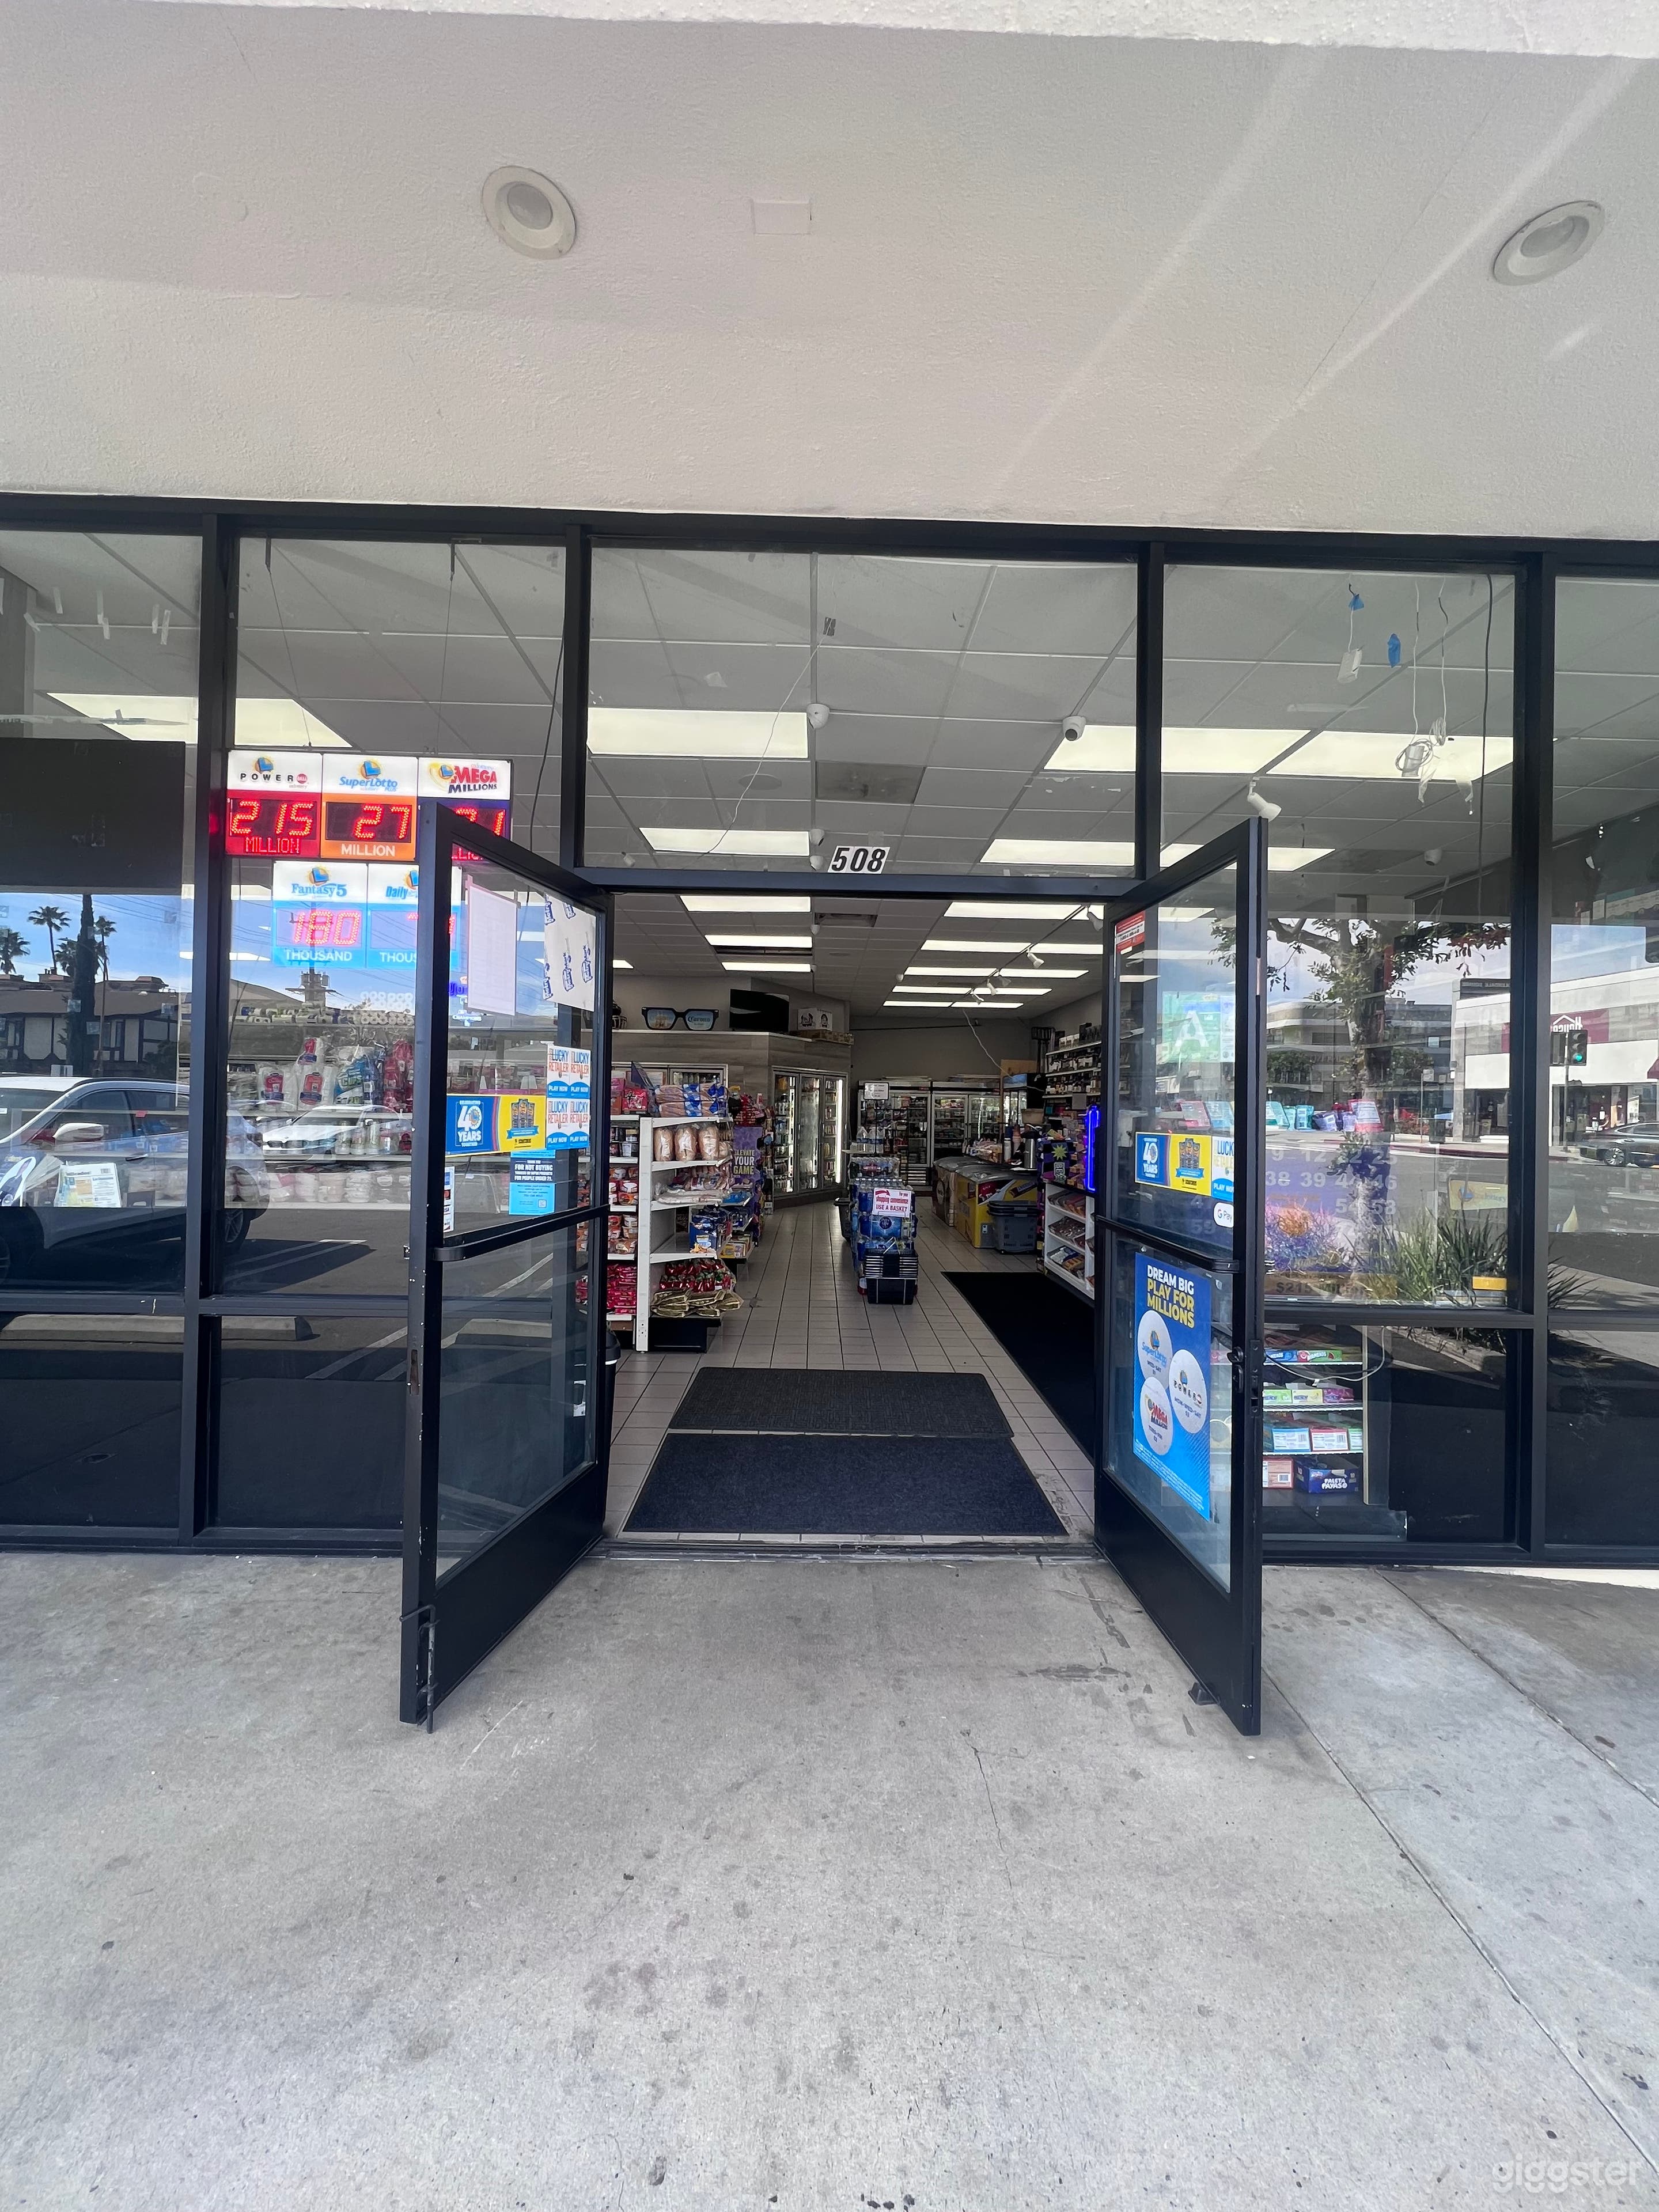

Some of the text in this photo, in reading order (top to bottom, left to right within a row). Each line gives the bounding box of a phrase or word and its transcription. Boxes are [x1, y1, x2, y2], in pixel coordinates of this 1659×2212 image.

[240, 772, 294, 782] POWER
[450, 766, 497, 784] MEGA
[339, 776, 398, 790] SuperLotto
[448, 783, 497, 793] MILLIONS
[230, 800, 315, 836] 215
[354, 804, 411, 839] 27
[244, 837, 301, 854] MILLION
[341, 843, 395, 857] MILLION
[831, 847, 886, 872] 508
[291, 883, 347, 897] Fantasy 5
[385, 885, 408, 900] Daily
[294, 910, 361, 945] 180
[284, 949, 353, 961] THOUSAND
[1175, 1010, 1209, 1047] A
[552, 1048, 569, 1062] LUCKY
[574, 1051, 589, 1065] LUCKY
[548, 1062, 569, 1073] RETAILER
[571, 1065, 589, 1075] RETAILER
[551, 1101, 568, 1113] LUCKY
[573, 1101, 589, 1113] LUCKY
[457, 1105, 482, 1131] 40
[548, 1113, 568, 1123] RETAILER
[570, 1113, 589, 1123] RETAILER
[457, 1130, 482, 1142] YEARS
[1143, 1142, 1158, 1164] 40
[734, 1156, 755, 1166] YOUR
[733, 1165, 755, 1175] GAME
[1143, 1163, 1158, 1175] YEARS
[1265, 1171, 1290, 1186] 38
[1300, 1172, 1326, 1188] 39
[1213, 1183, 1225, 1192] PLAY
[1217, 1209, 1232, 1224] G Pay
[1147, 1264, 1194, 1296] DREAM BIG
[1147, 1278, 1195, 1312] PLAY FOR
[1147, 1292, 1195, 1328] MILLIONS
[1152, 1402, 1168, 1425] MEGA
